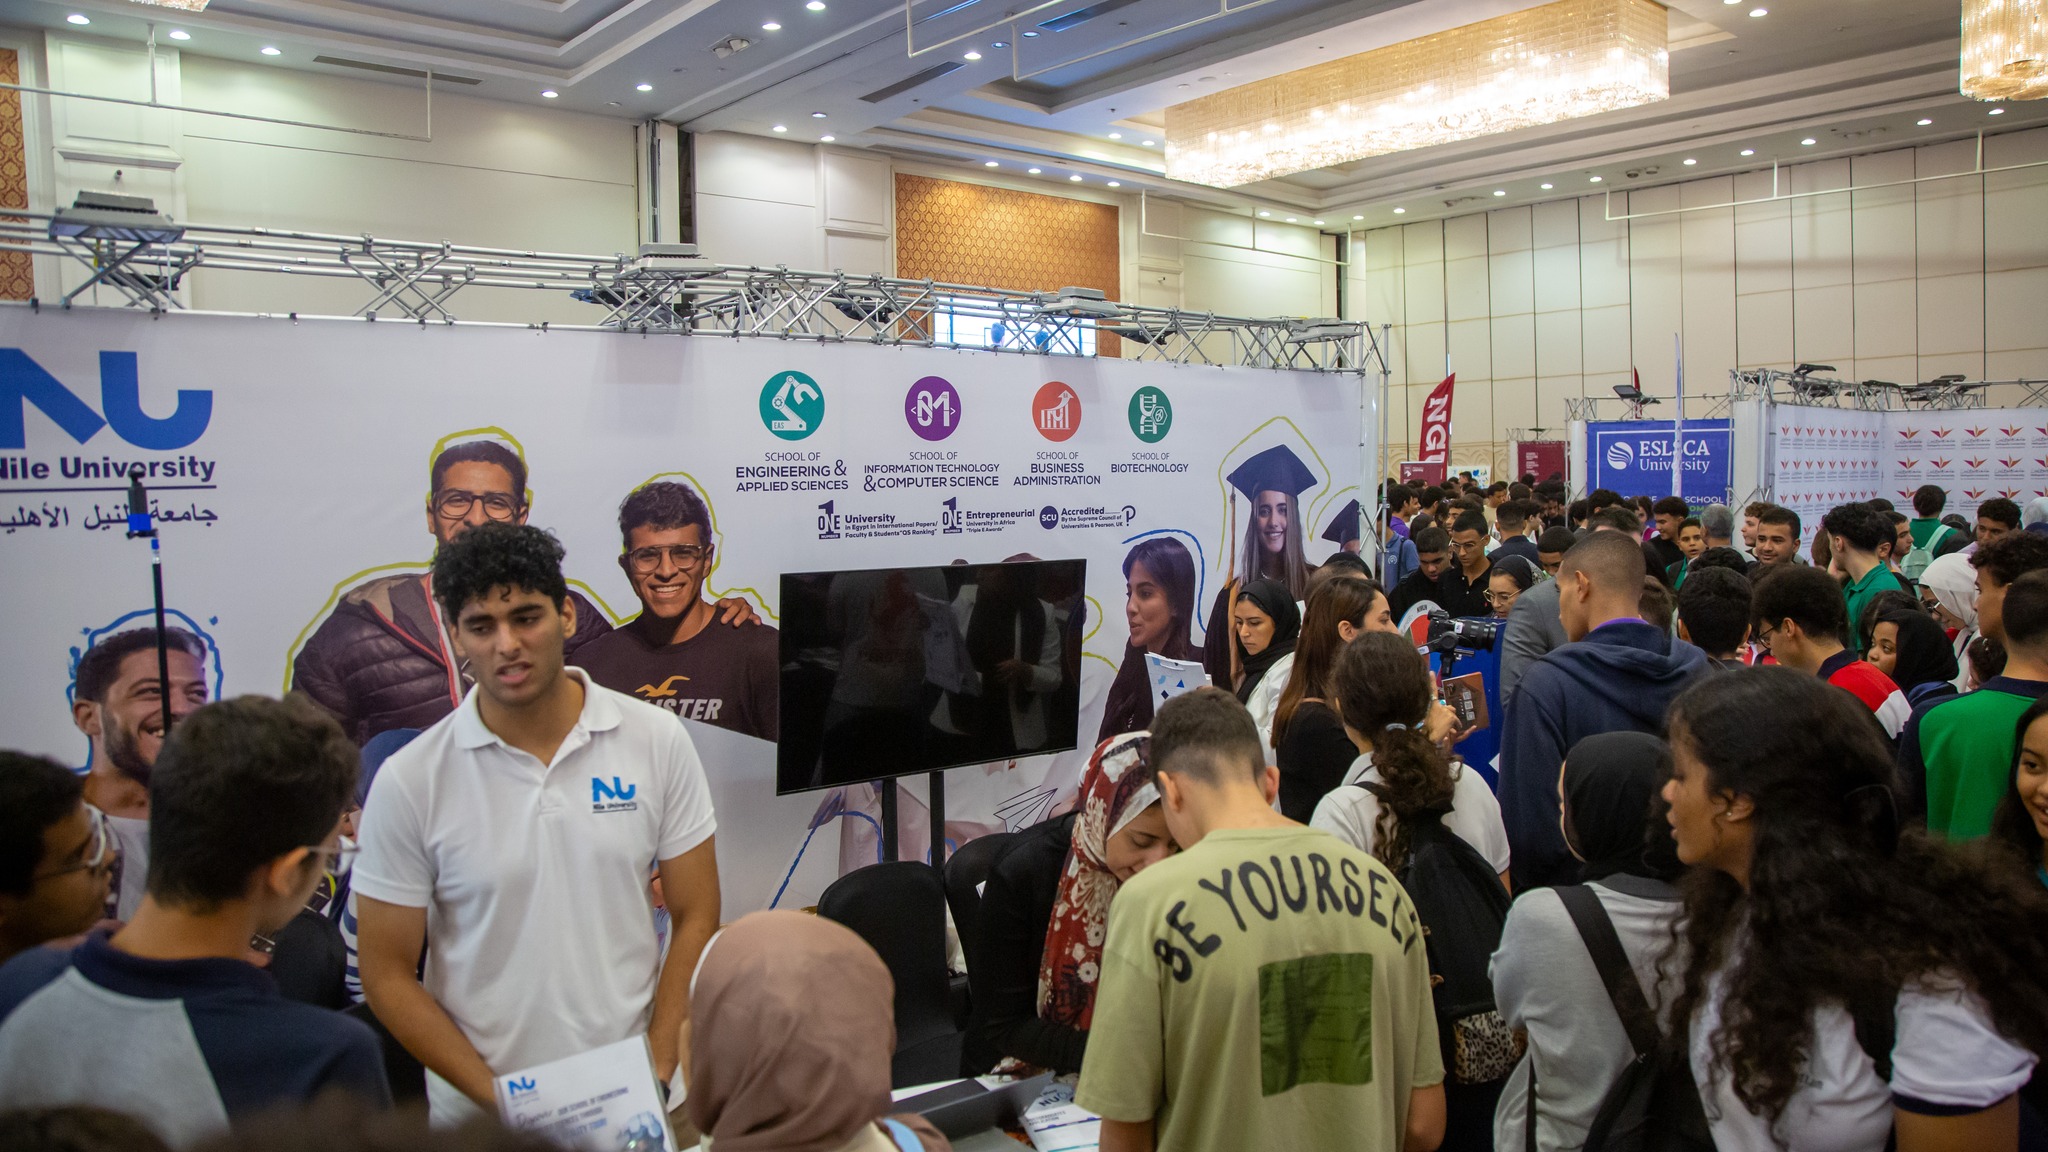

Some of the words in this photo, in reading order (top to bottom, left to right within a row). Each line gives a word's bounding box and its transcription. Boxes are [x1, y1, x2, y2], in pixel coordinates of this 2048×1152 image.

[774, 422, 785, 430] EAS
[1639, 439, 1711, 457] ESLCA
[765, 452, 806, 462] SCHOOL
[808, 452, 821, 461] OF
[909, 451, 944, 460] SCHOOL
[946, 451, 958, 460] OF
[1036, 451, 1067, 460] SCHOOL
[1069, 451, 1079, 460] OF
[1131, 452, 1160, 461] SCHOOL
[1161, 452, 1170, 460] OF
[736, 465, 831, 478] ENGINEERING
[834, 459, 847, 476] &
[864, 464, 934, 474] INFORMATION
[935, 463, 1000, 473] TECHNOLOGY
[1030, 463, 1085, 473] BUSINESS
[1110, 463, 1189, 473] BIOTECHNOLOGY
[1640, 457, 1711, 474] Univrsity
[736, 481, 789, 492] APPLIED
[791, 480, 849, 491] SCIENCES
[949, 476, 999, 487] SCIENCE
[1013, 475, 1101, 486] ADMINISTRATION
[1684, 495, 1724, 504] SCHOOL
[83, 503, 131, 531] لنيل
[150, 499, 218, 527] جامعة
[966, 509, 1035, 520] Entrepreneurial
[1061, 507, 1105, 516] Accredited
[0, 501, 69, 534] الأهلي
[845, 513, 896, 524] University
[1041, 514, 1057, 522] SCU
[852, 524, 869, 532] Egypt
[845, 531, 867, 539] Faculty
[592, 776, 636, 802] NU
[1153, 900, 1222, 984] BE
[508, 1076, 536, 1096] NU
